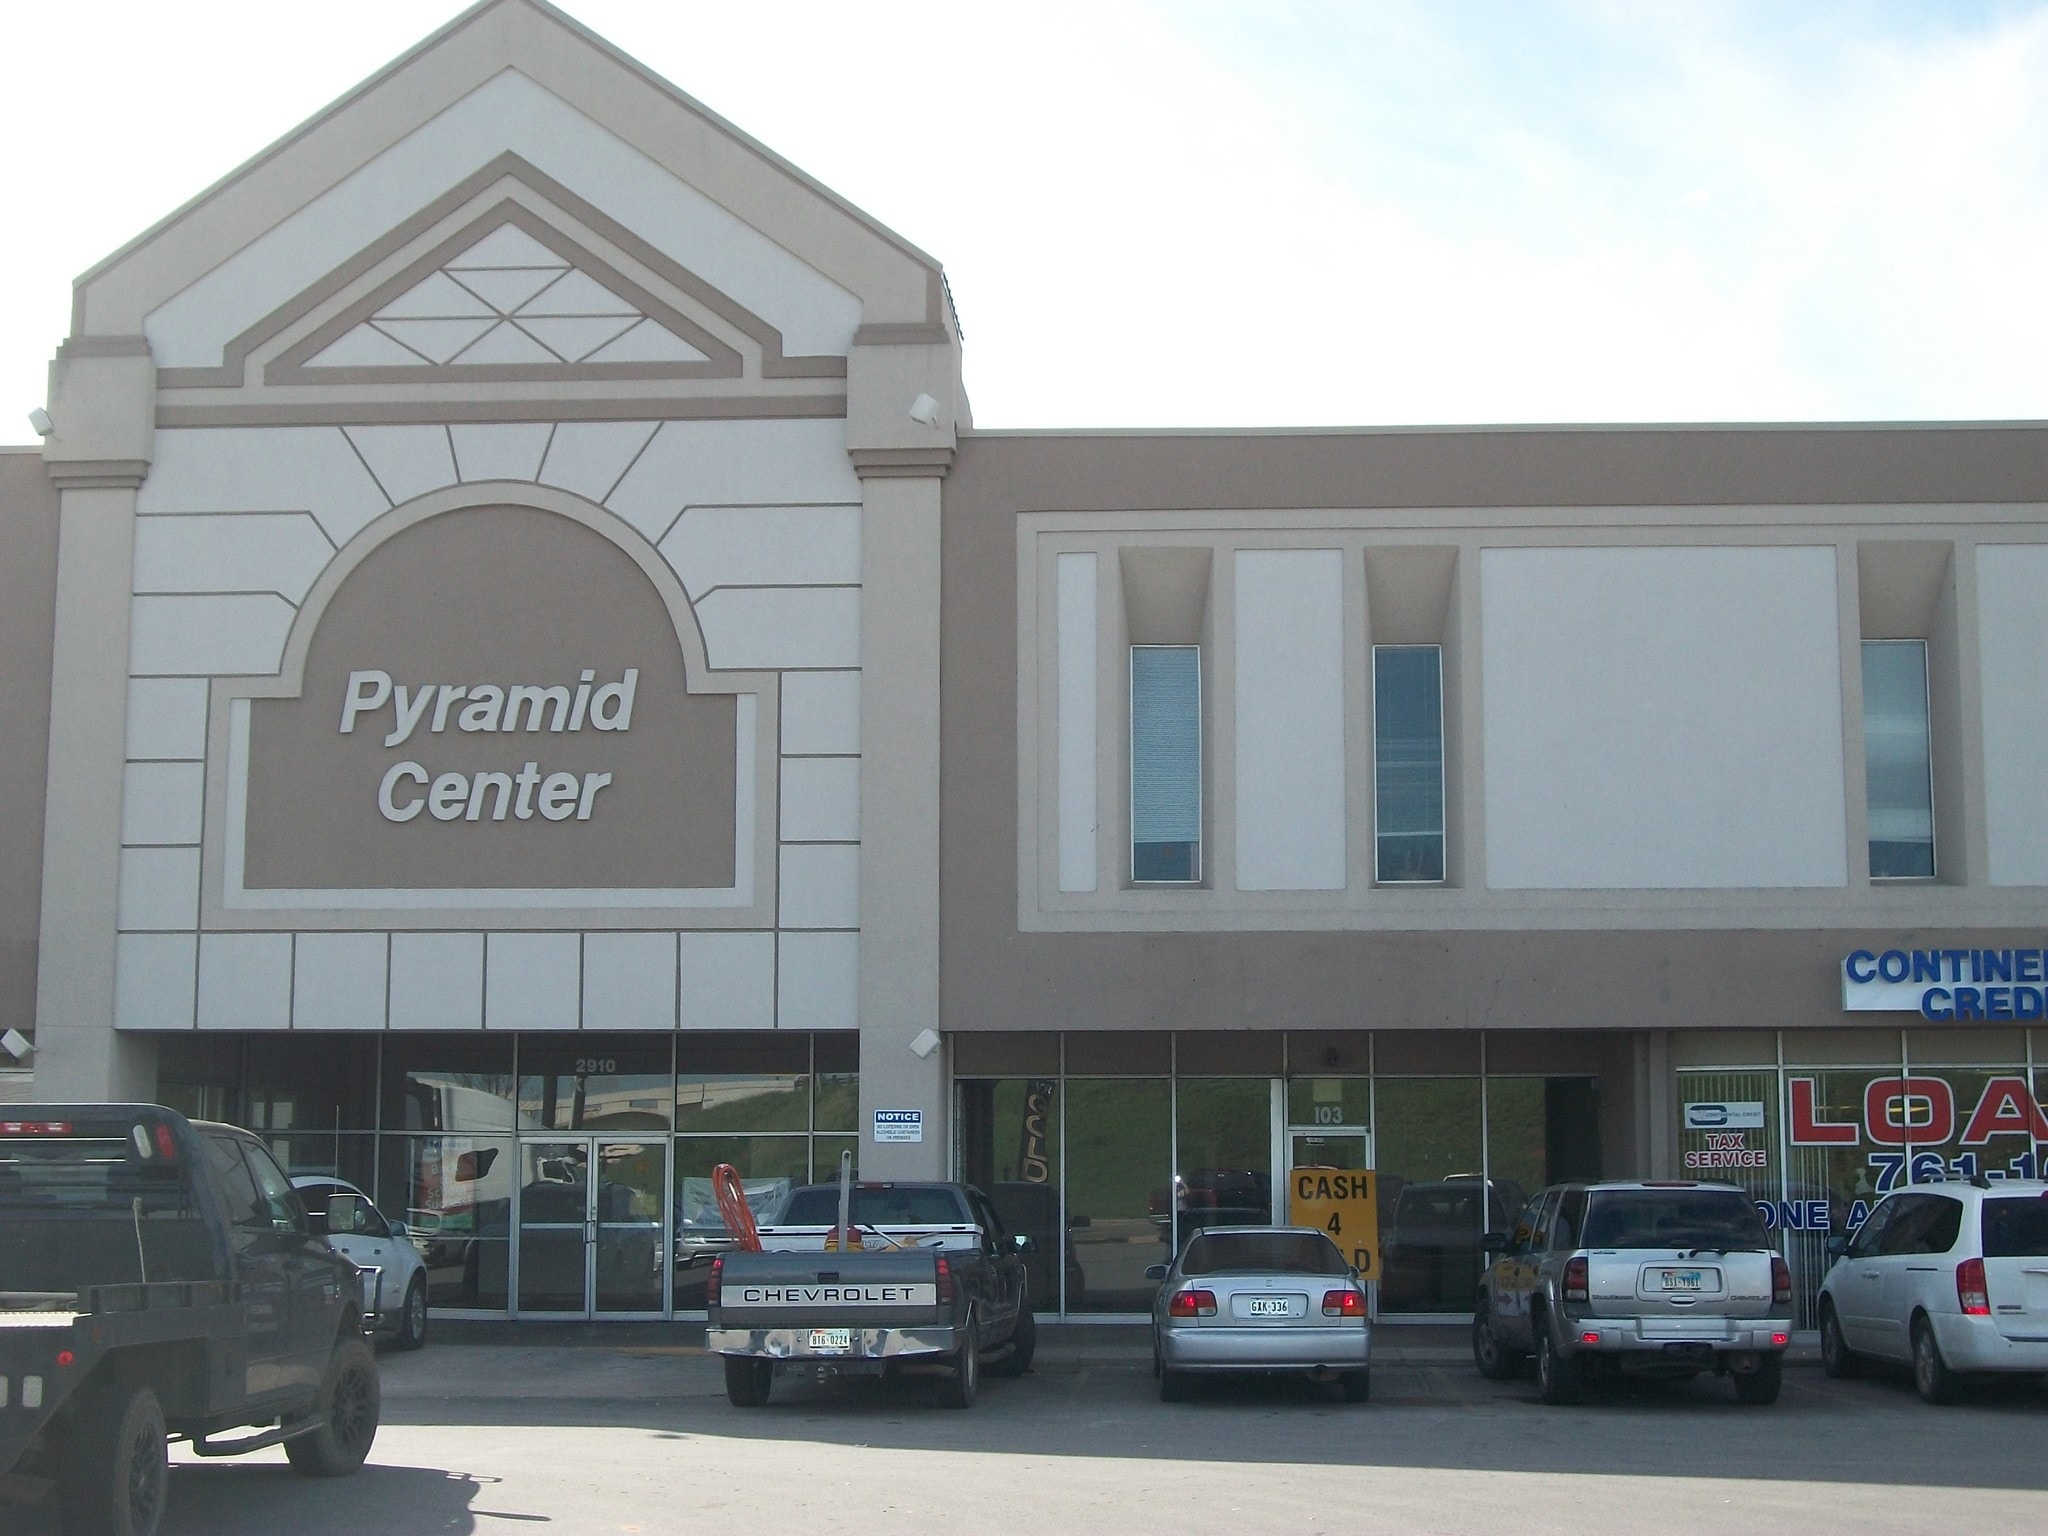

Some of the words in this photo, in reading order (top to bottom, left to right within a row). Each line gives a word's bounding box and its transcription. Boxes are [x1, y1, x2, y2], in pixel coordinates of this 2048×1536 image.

[340, 668, 639, 747] Pyramid
[378, 761, 612, 822] Center
[1846, 949, 2048, 984] CONTINE
[576, 1059, 616, 1073] 2910
[877, 1113, 920, 1121] NOTICE
[1315, 1106, 1343, 1124] 103
[1705, 1133, 1745, 1150] TAX
[1684, 1150, 1767, 1168] SERVICE
[1298, 1175, 1368, 1200] CASH
[1327, 1211, 1342, 1236] 4
[743, 1288, 914, 1302] CHEVROLET
